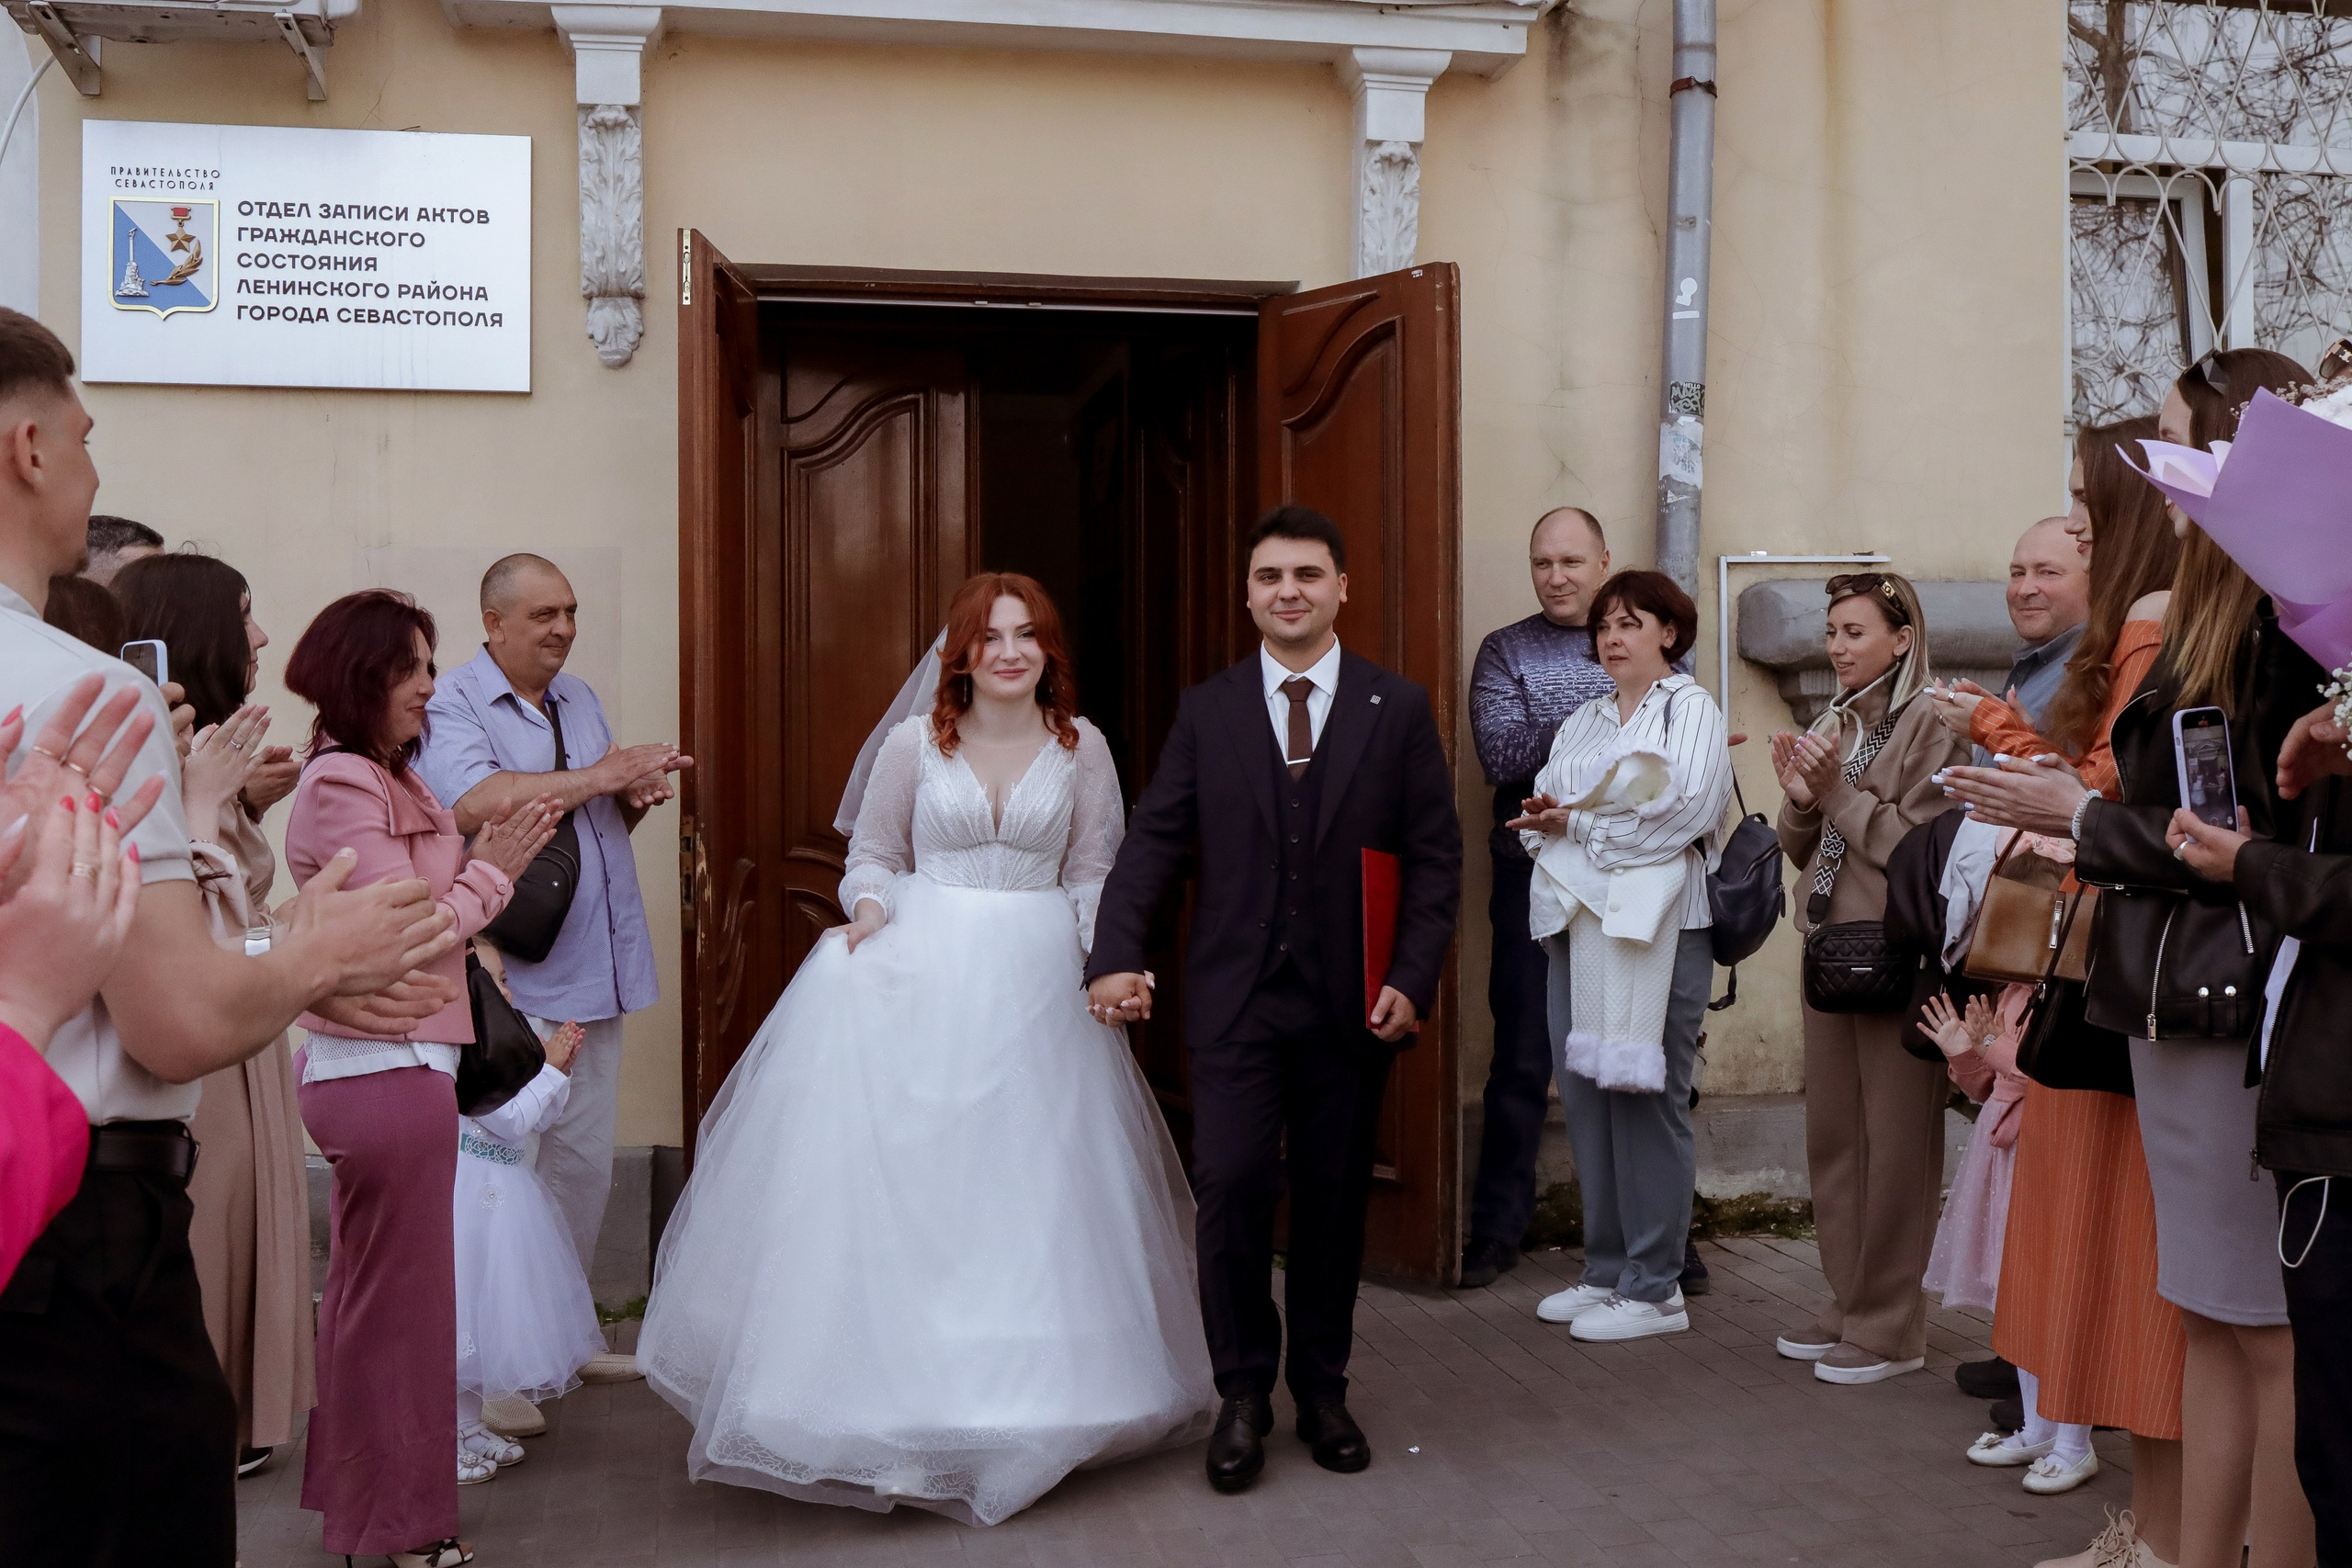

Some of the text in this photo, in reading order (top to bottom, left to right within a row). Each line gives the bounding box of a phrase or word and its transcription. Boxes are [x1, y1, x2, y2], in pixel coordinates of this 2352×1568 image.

[110, 165, 220, 179] ПРАВИТЕЛЬСТВО
[114, 178, 214, 191] СЕВАСТОПОЛЯ
[237, 200, 491, 225] ОТДЕЛ ЗАПИСИ АКТОВ
[237, 226, 426, 249] ГРАЖДАНСКОГО
[236, 252, 379, 273] СОСТОЯНИЯ
[236, 278, 489, 301] ЛЕНИНСКОГО РАЙОНА
[237, 304, 503, 328] ГОРОДА СЕВАСТОПОЛЯ
